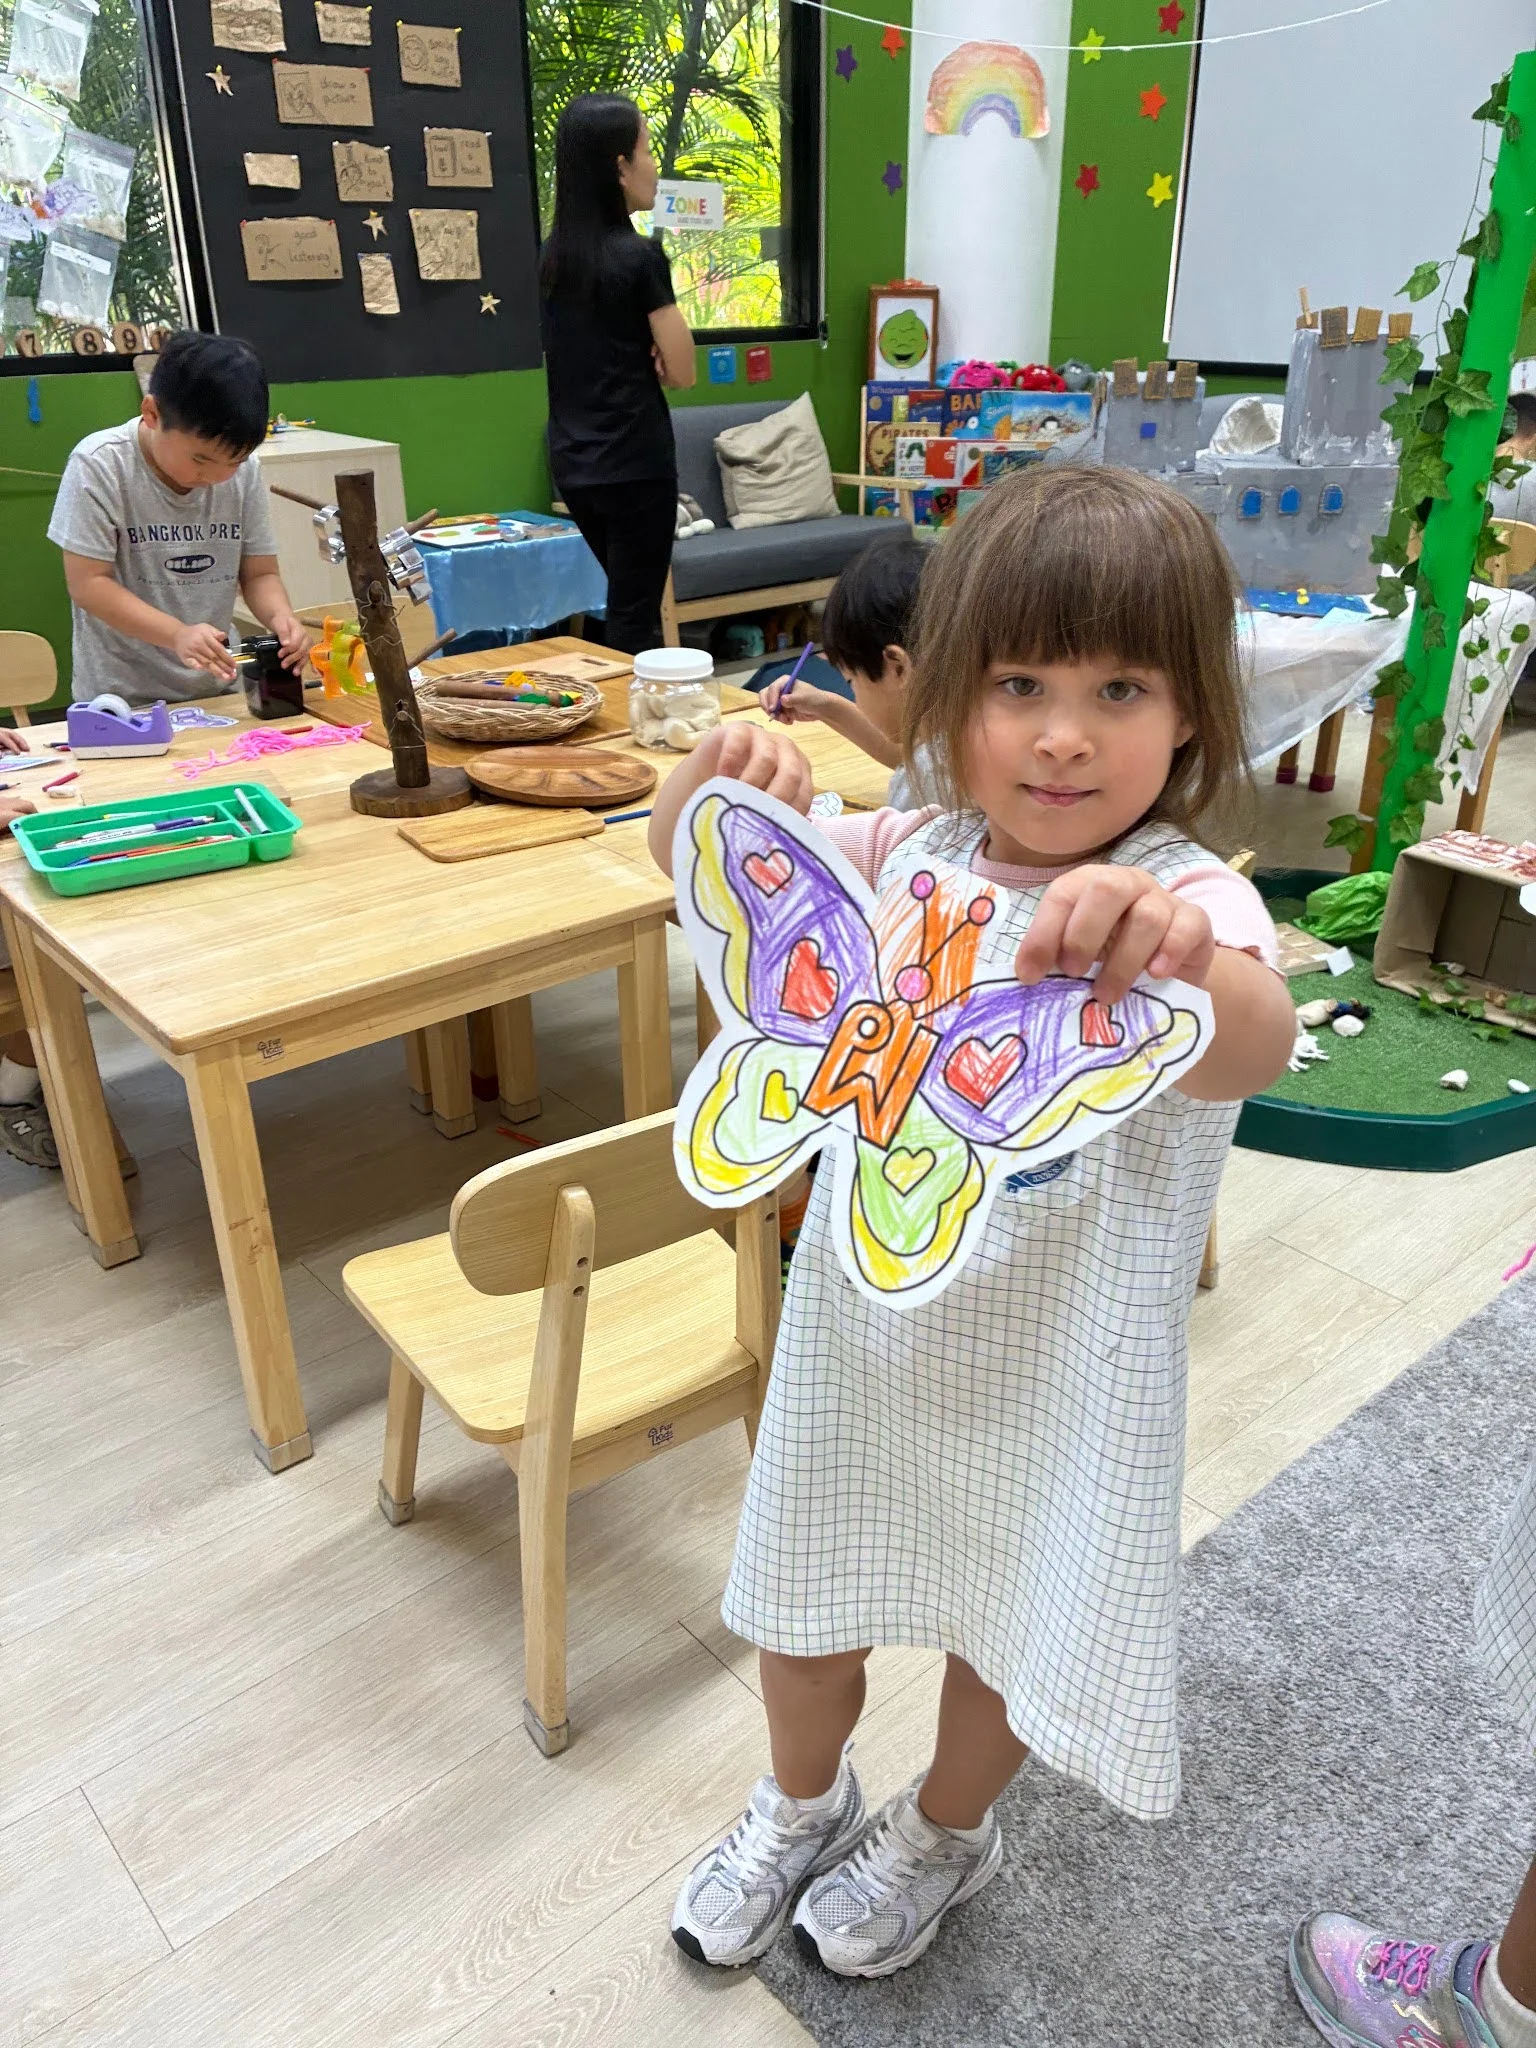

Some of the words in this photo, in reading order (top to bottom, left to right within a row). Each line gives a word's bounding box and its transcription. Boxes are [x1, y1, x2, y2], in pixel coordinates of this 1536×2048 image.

[665, 196, 707, 215] ZONE
[25, 332, 37, 355] 7
[83, 332, 98, 353] 8
[123, 328, 137, 350] 9
[882, 428, 930, 438] PIRATES
[127, 525, 204, 543] BANGKOK
[659, 1422, 674, 1433] Fur
[655, 1430, 674, 1442] Kids
